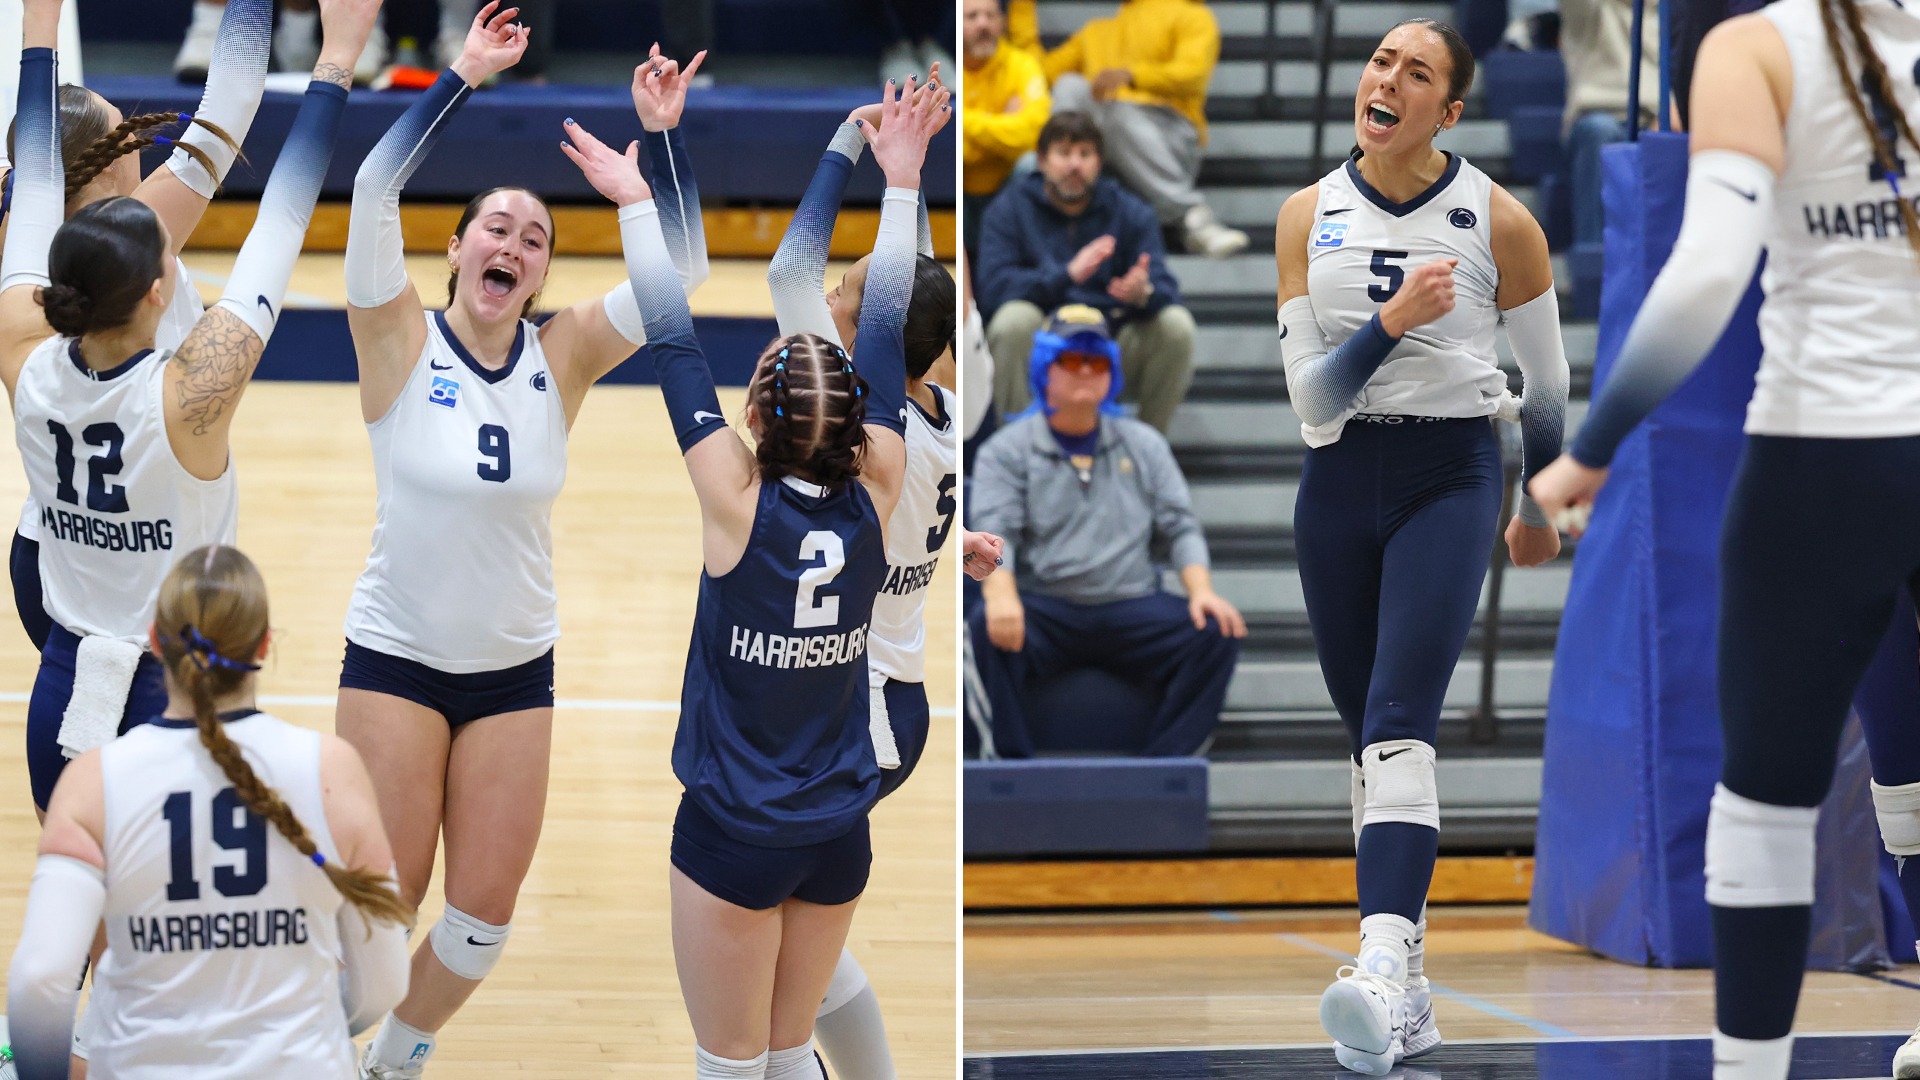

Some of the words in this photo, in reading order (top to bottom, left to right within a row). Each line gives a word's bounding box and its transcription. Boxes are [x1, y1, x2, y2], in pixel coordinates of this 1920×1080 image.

[1368, 250, 1408, 303] 5
[47, 419, 130, 513] 12
[477, 423, 511, 483] 9
[793, 530, 845, 629] 2
[729, 622, 867, 669] HARRISBURG
[162, 787, 268, 901] 19
[129, 908, 308, 953] HARRISBURG
